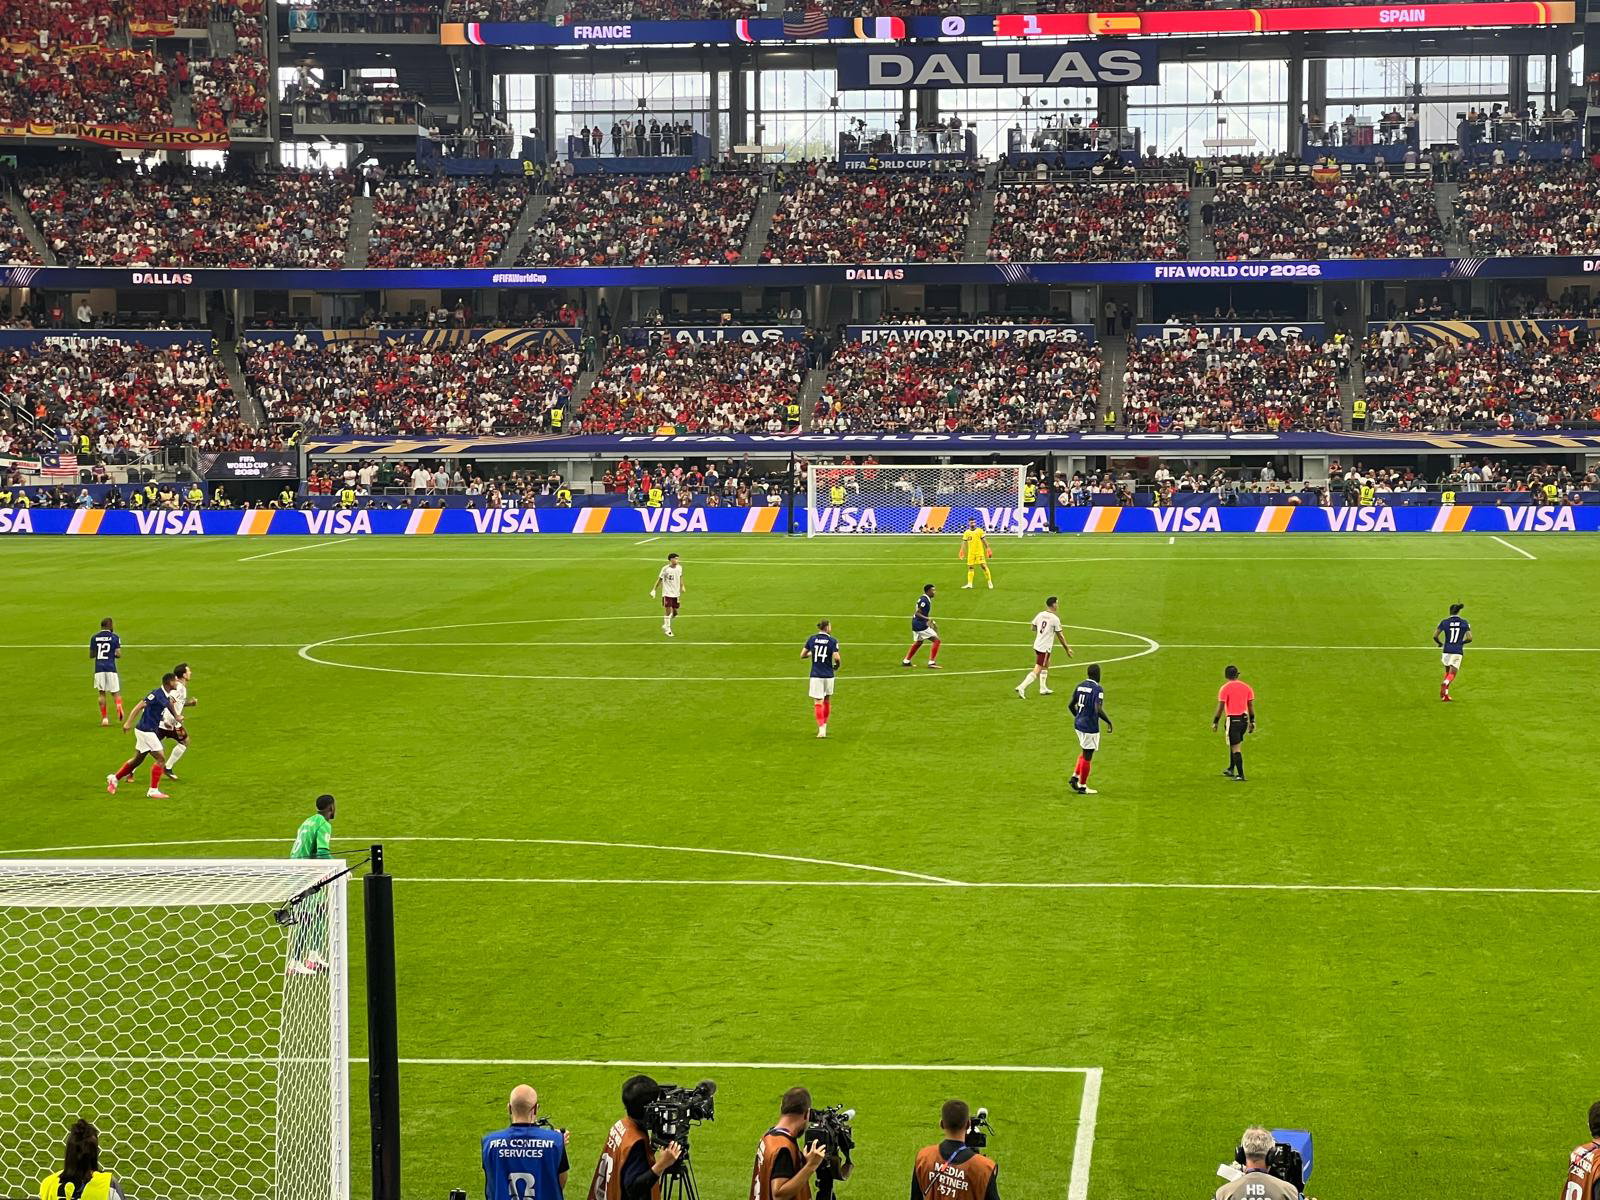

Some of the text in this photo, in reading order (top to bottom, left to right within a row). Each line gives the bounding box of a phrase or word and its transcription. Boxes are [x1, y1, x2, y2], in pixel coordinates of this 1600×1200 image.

[1023, 15, 1042, 34] 1
[1379, 9, 1425, 23] SPAIN
[573, 26, 632, 38] FRANCE
[942, 16, 965, 36] 0
[868, 49, 1142, 85] DALLAS
[845, 161, 866, 169] FIFA
[879, 161, 905, 169] ORLD
[906, 160, 926, 168] CUP
[132, 273, 193, 284] DALLAS
[492, 273, 547, 284] #FIFAWorldCup
[846, 269, 904, 280] DALLAS
[1155, 265, 1321, 278] FIFA WORLD CUP 2026
[861, 330, 900, 345] FIFA
[903, 329, 973, 345] WORLD
[973, 329, 1010, 343] CUP
[1162, 327, 1303, 343] DLLAS
[130, 510, 204, 534] VISA
[299, 510, 372, 534] VISA
[466, 509, 540, 533] VISA
[635, 508, 708, 532] VISA
[803, 507, 878, 532] VISA
[974, 507, 1050, 532] VISA
[1148, 507, 1222, 531] VISA
[1323, 507, 1397, 531] VISA
[1502, 506, 1576, 531] VISA
[96, 642, 111, 660] 12
[814, 645, 828, 663] 14
[1078, 693, 1086, 714] 4
[490, 1139, 554, 1149] FIFA CONTENT
[498, 1149, 543, 1158] SERVICES
[928, 1171, 969, 1191] PRTNER
[1246, 1184, 1265, 1196] HB
